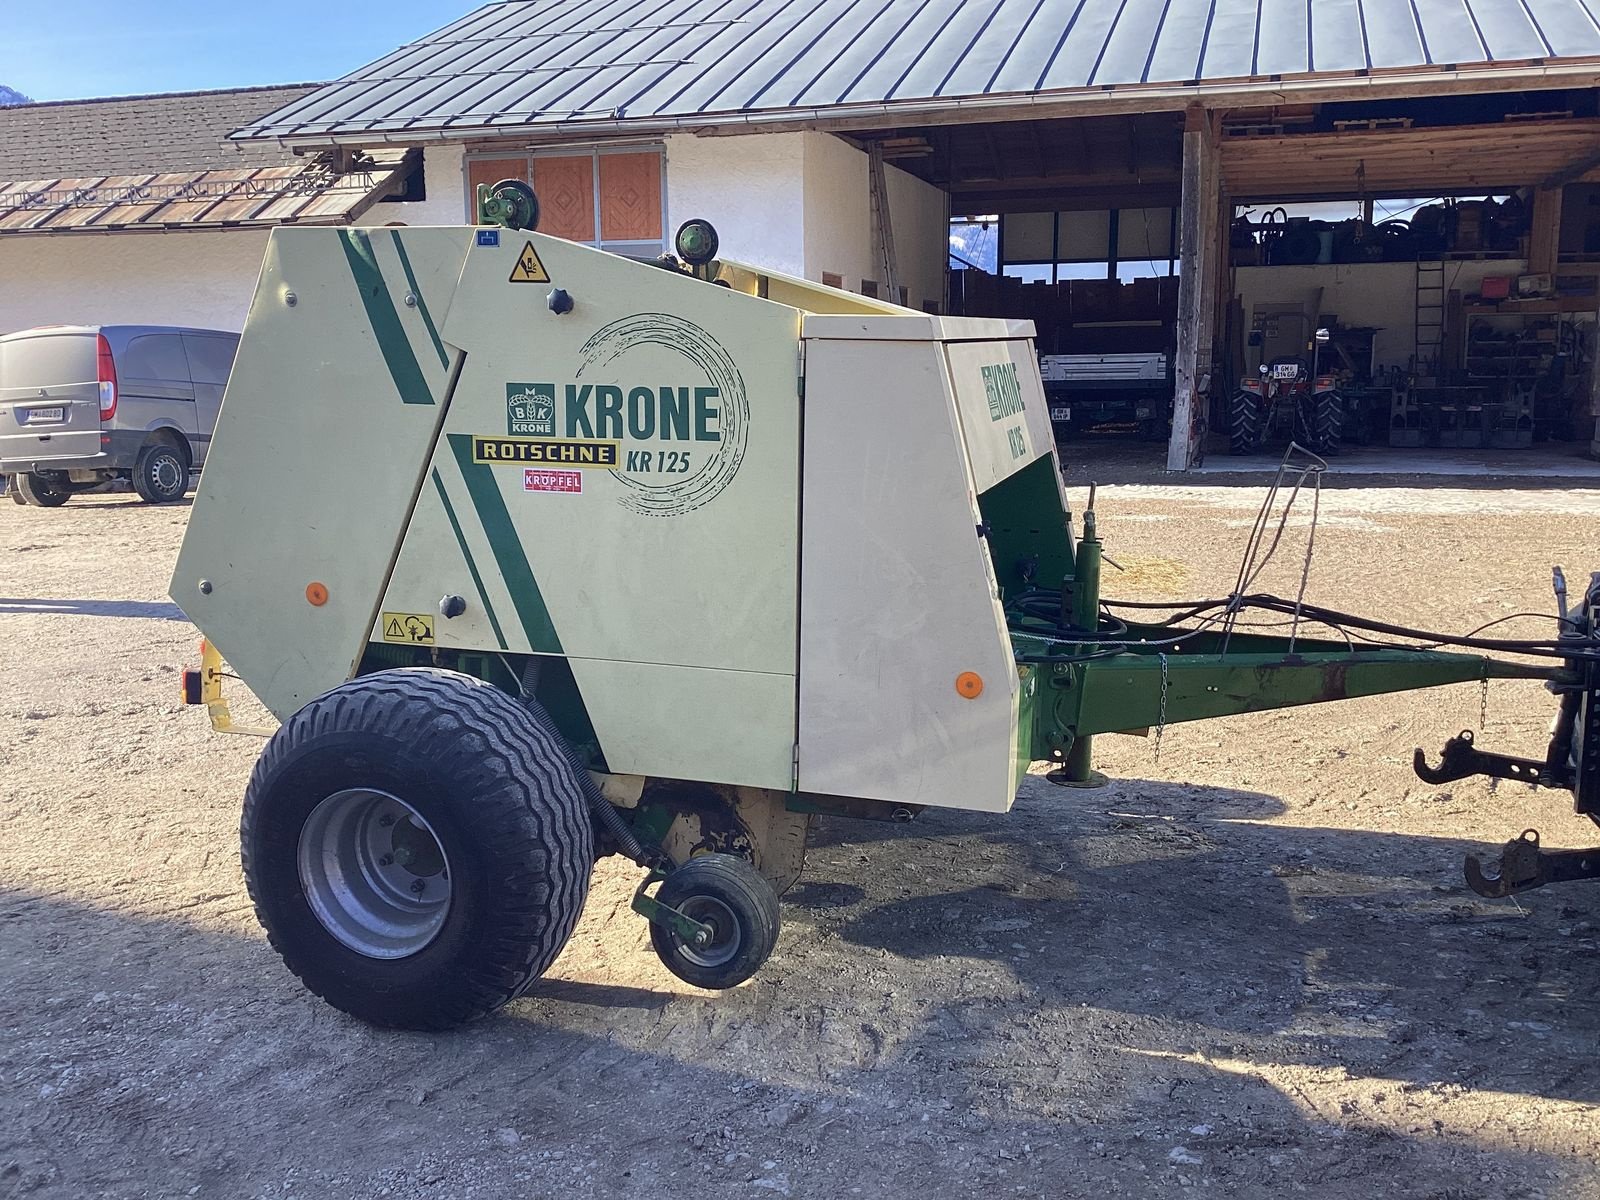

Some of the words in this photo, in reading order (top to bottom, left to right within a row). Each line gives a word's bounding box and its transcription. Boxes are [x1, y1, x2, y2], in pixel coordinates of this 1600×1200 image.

[525, 387, 536, 396] M
[989, 362, 1025, 418] KRONE
[515, 407, 525, 419] B
[537, 407, 548, 419] K
[565, 384, 720, 441] KRONE
[512, 423, 551, 433] KRONE
[483, 442, 610, 462] ROTSCHNE
[626, 451, 652, 473] KR
[657, 452, 691, 473] 125
[525, 475, 581, 488] KRÖPFEL
